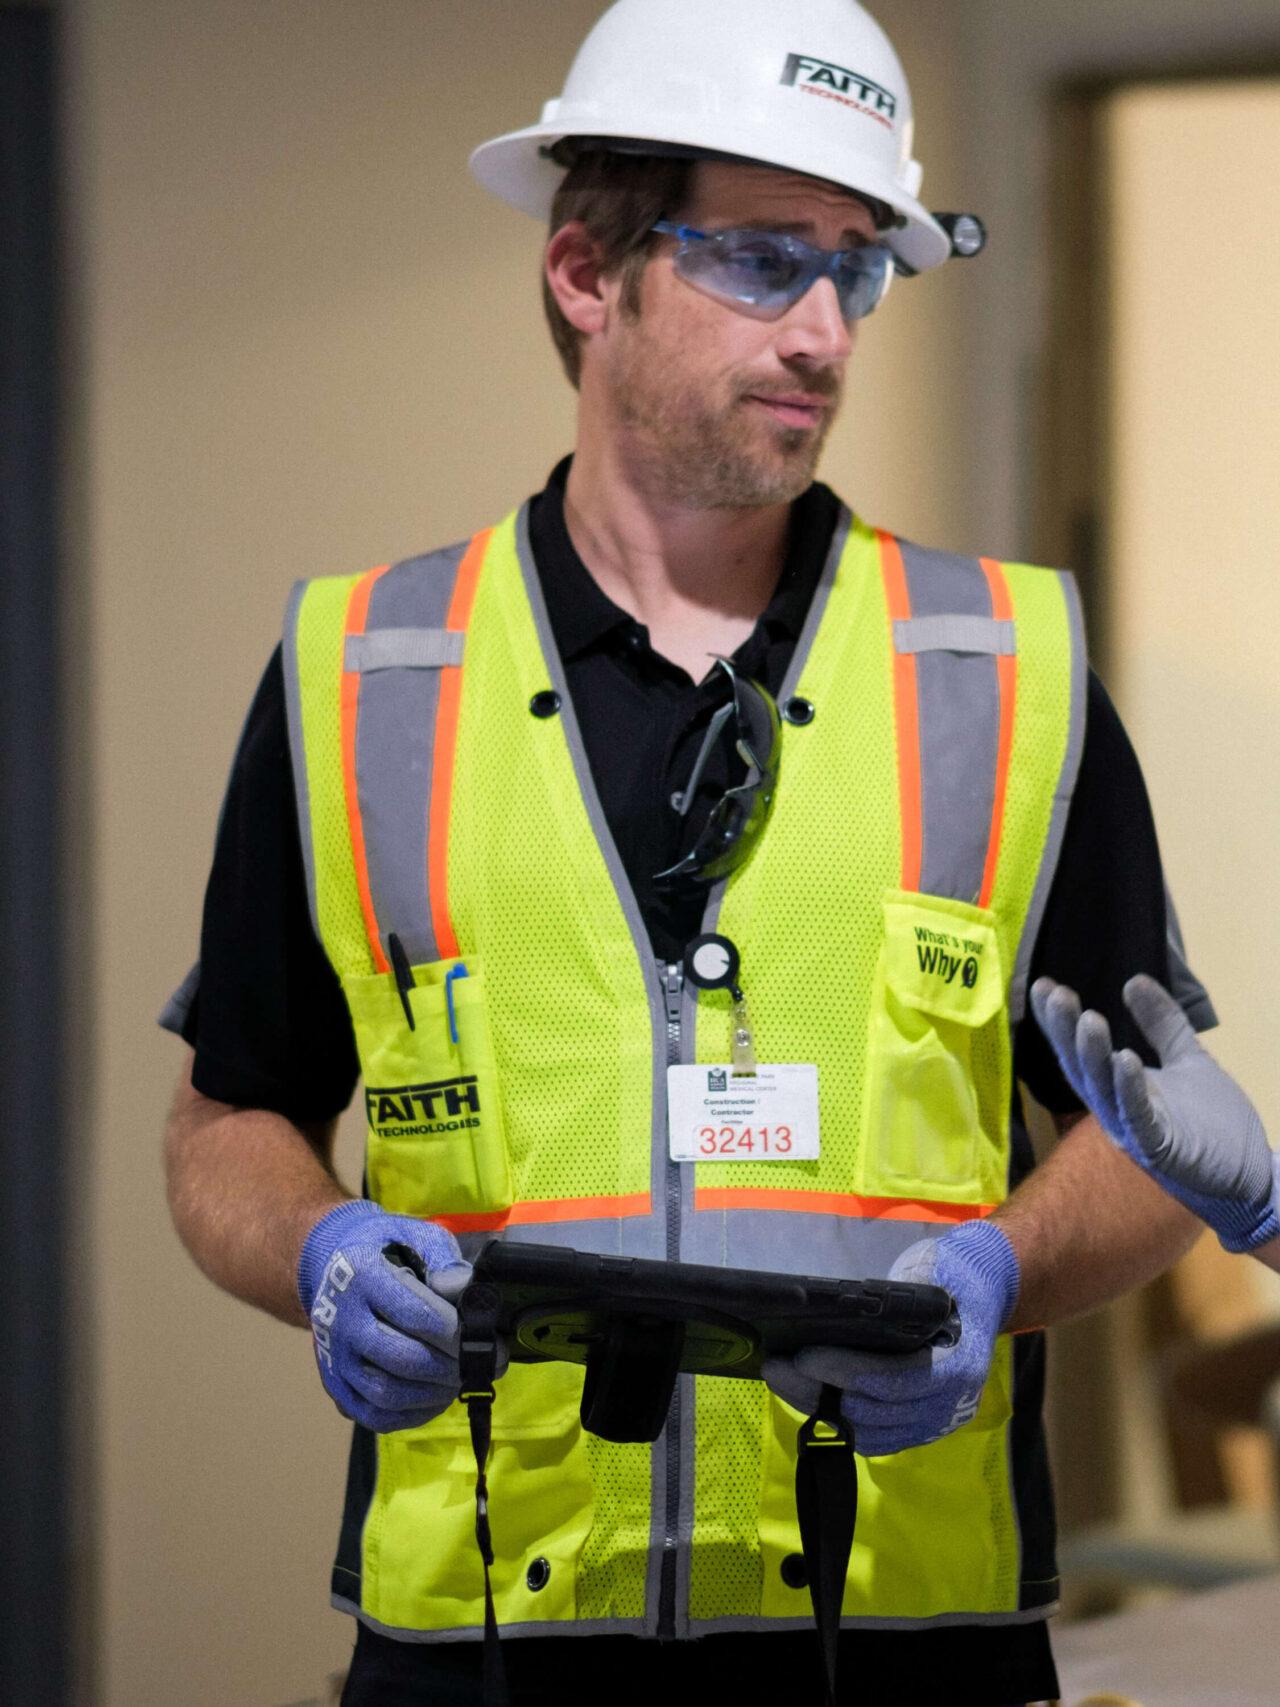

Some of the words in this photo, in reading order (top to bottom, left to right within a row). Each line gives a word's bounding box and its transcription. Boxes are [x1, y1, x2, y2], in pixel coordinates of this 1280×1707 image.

[779, 52, 896, 119] FAITH
[365, 1075, 480, 1135] FAITH
[377, 1117, 481, 1137] TECHNOLOGIES
[700, 1126, 792, 1154] 32413
